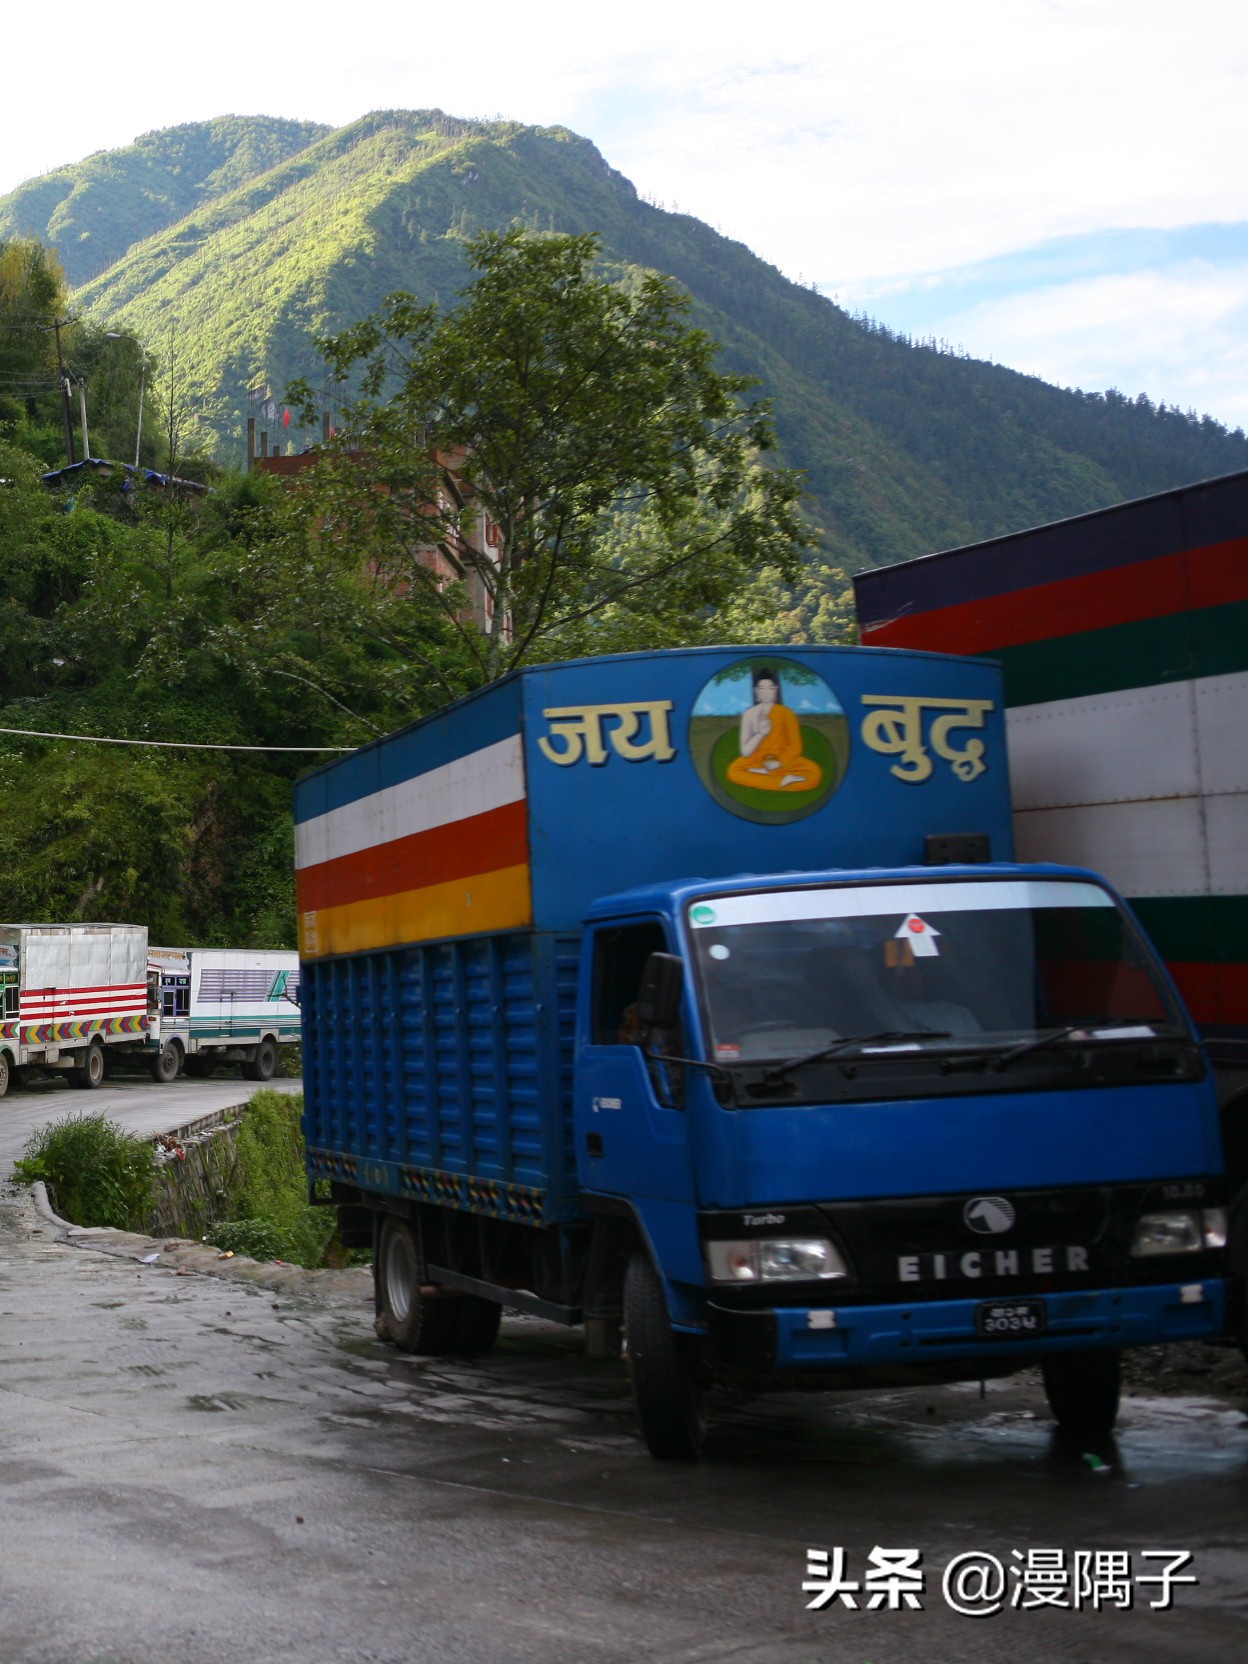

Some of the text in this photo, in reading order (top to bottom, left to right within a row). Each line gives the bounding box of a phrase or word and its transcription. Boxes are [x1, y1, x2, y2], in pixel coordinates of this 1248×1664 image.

[537, 700, 677, 767] जय
[742, 1213, 785, 1226] Turbo
[898, 1246, 1090, 1281] EICHER
